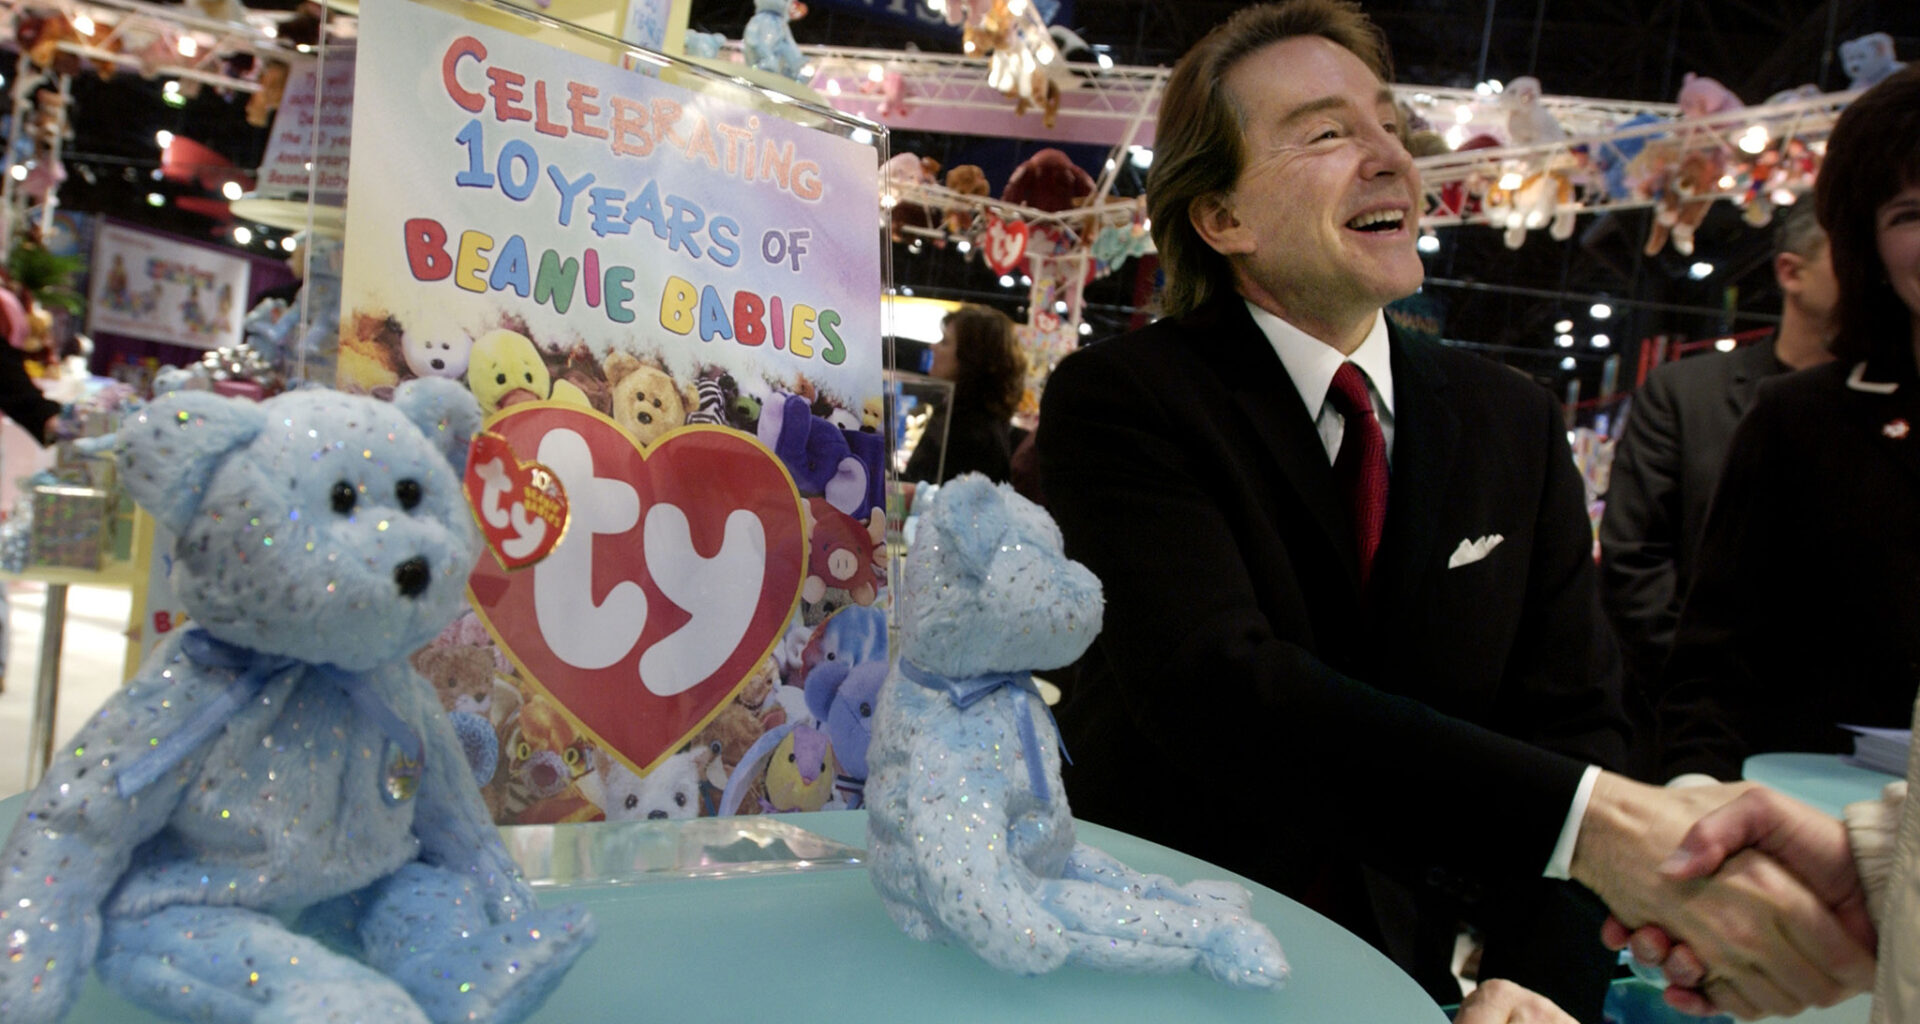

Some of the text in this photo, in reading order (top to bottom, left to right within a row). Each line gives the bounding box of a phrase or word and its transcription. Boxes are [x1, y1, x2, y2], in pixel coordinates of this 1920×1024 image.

[442, 36, 823, 200] CELEBRATING
[455, 119, 811, 271] 10 YEARS OF
[989, 221, 1024, 268] ty
[404, 218, 848, 365] BEANIE BABIES
[474, 456, 548, 560] ty
[534, 428, 767, 697] ty
